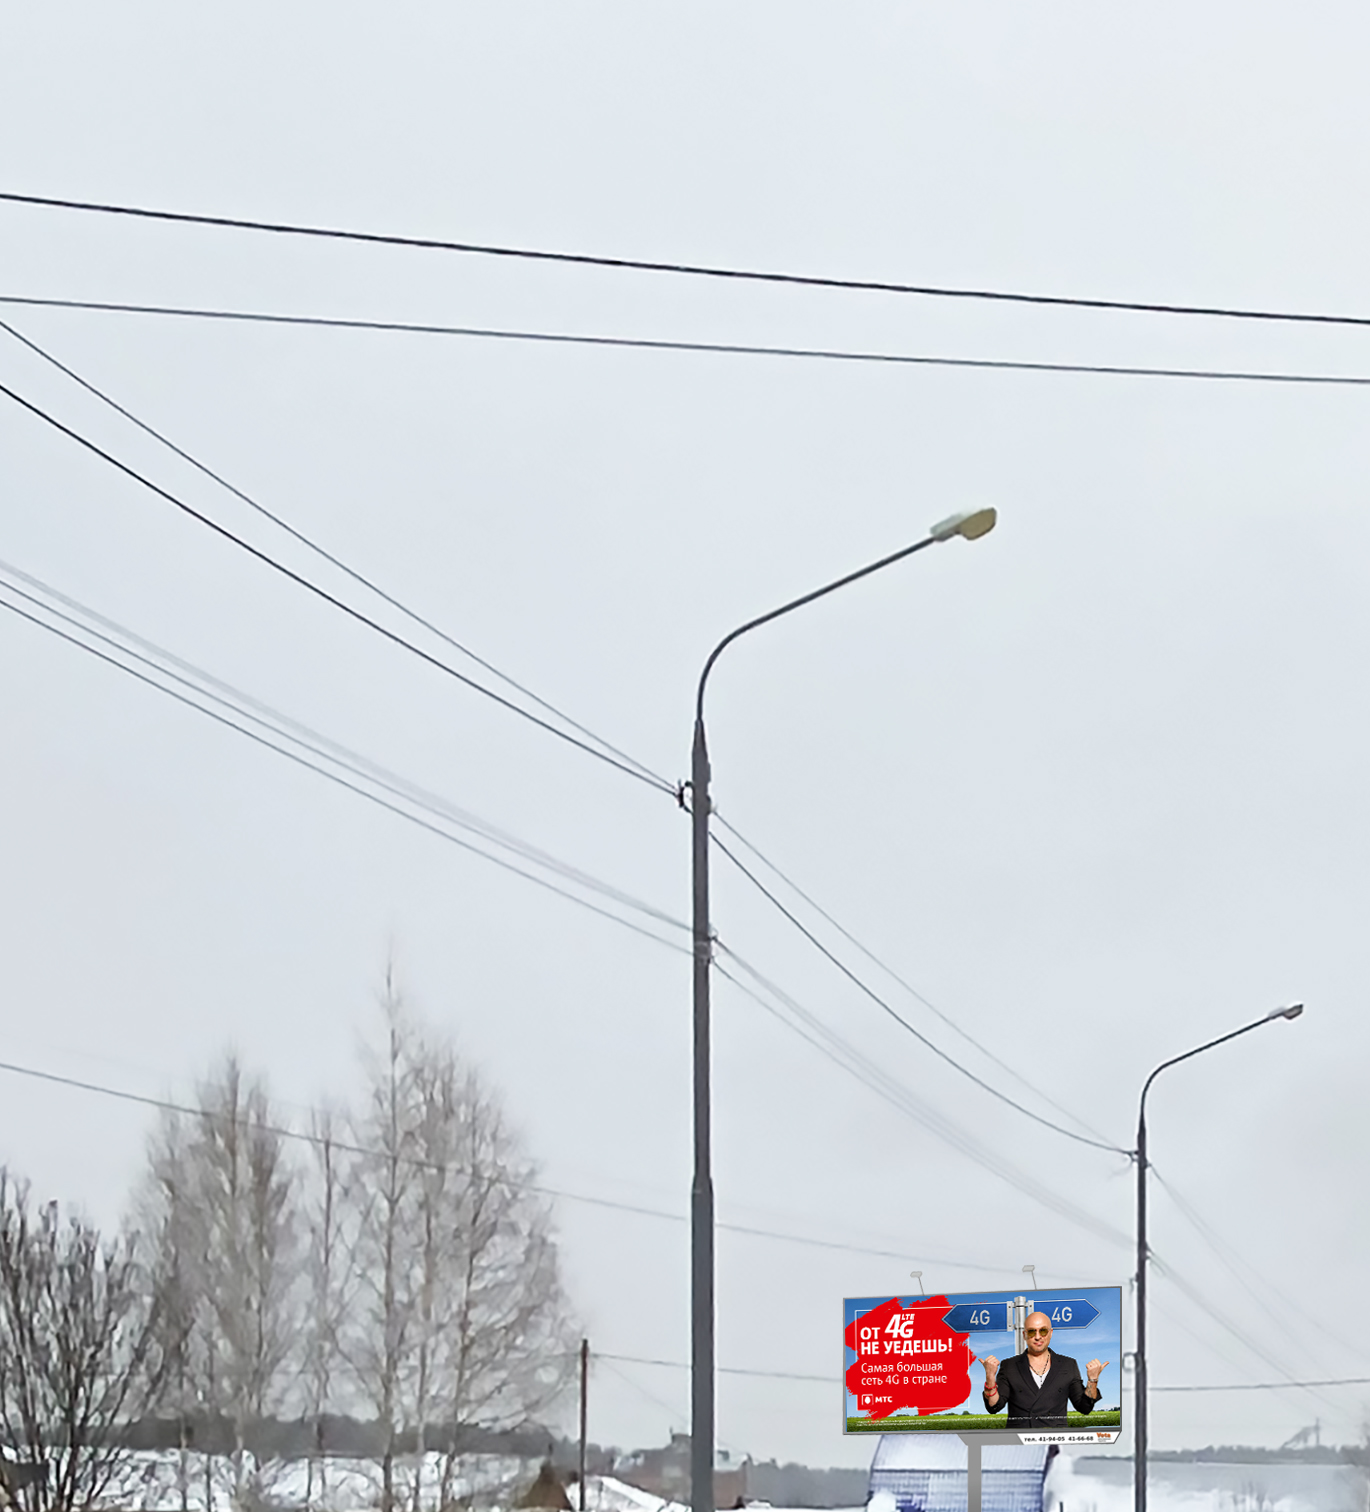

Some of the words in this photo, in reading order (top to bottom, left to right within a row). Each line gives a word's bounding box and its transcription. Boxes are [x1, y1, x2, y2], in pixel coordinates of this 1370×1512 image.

[969, 1309, 991, 1326] 4G
[1051, 1306, 1073, 1323] 4G
[860, 1326, 881, 1340] ОТ
[884, 1313, 914, 1339] 4G
[861, 1341, 880, 1355] НЕ
[883, 1338, 953, 1357] УЕДЕШЬ!
[861, 1362, 894, 1374] Самая
[896, 1361, 943, 1373] большая
[861, 1376, 884, 1386] сеть
[885, 1374, 900, 1385] 4G
[903, 1376, 909, 1385] в
[911, 1375, 948, 1386] стране
